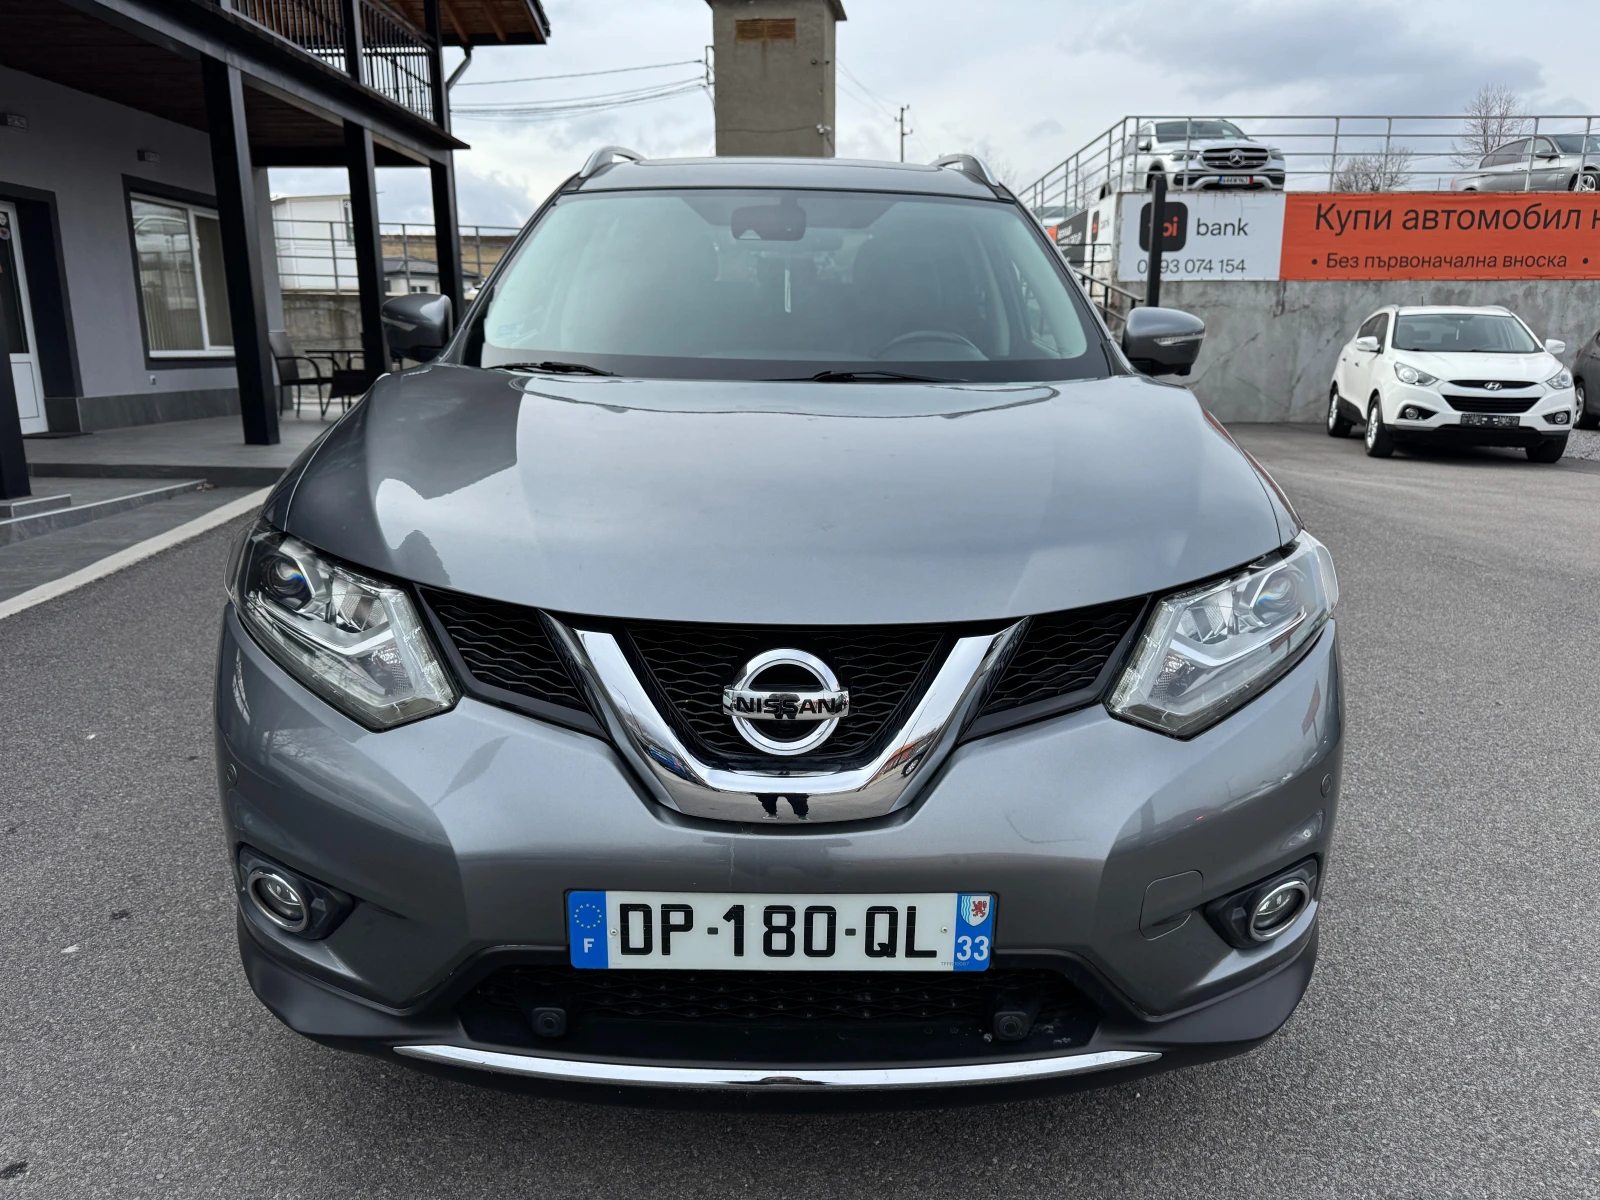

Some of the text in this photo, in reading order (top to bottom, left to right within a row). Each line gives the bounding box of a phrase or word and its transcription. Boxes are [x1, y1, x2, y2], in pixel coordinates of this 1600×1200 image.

[1196, 217, 1249, 237] bank
[1315, 203, 1392, 236] Купи
[1402, 203, 1581, 231] автомобил
[1137, 259, 1247, 274] 093 074 154
[1326, 252, 1567, 271] Без първоначална вноска
[736, 697, 836, 714] NISSAN
[620, 903, 937, 958] DP-180-QL
[583, 938, 595, 953] F
[956, 935, 989, 961] 33
